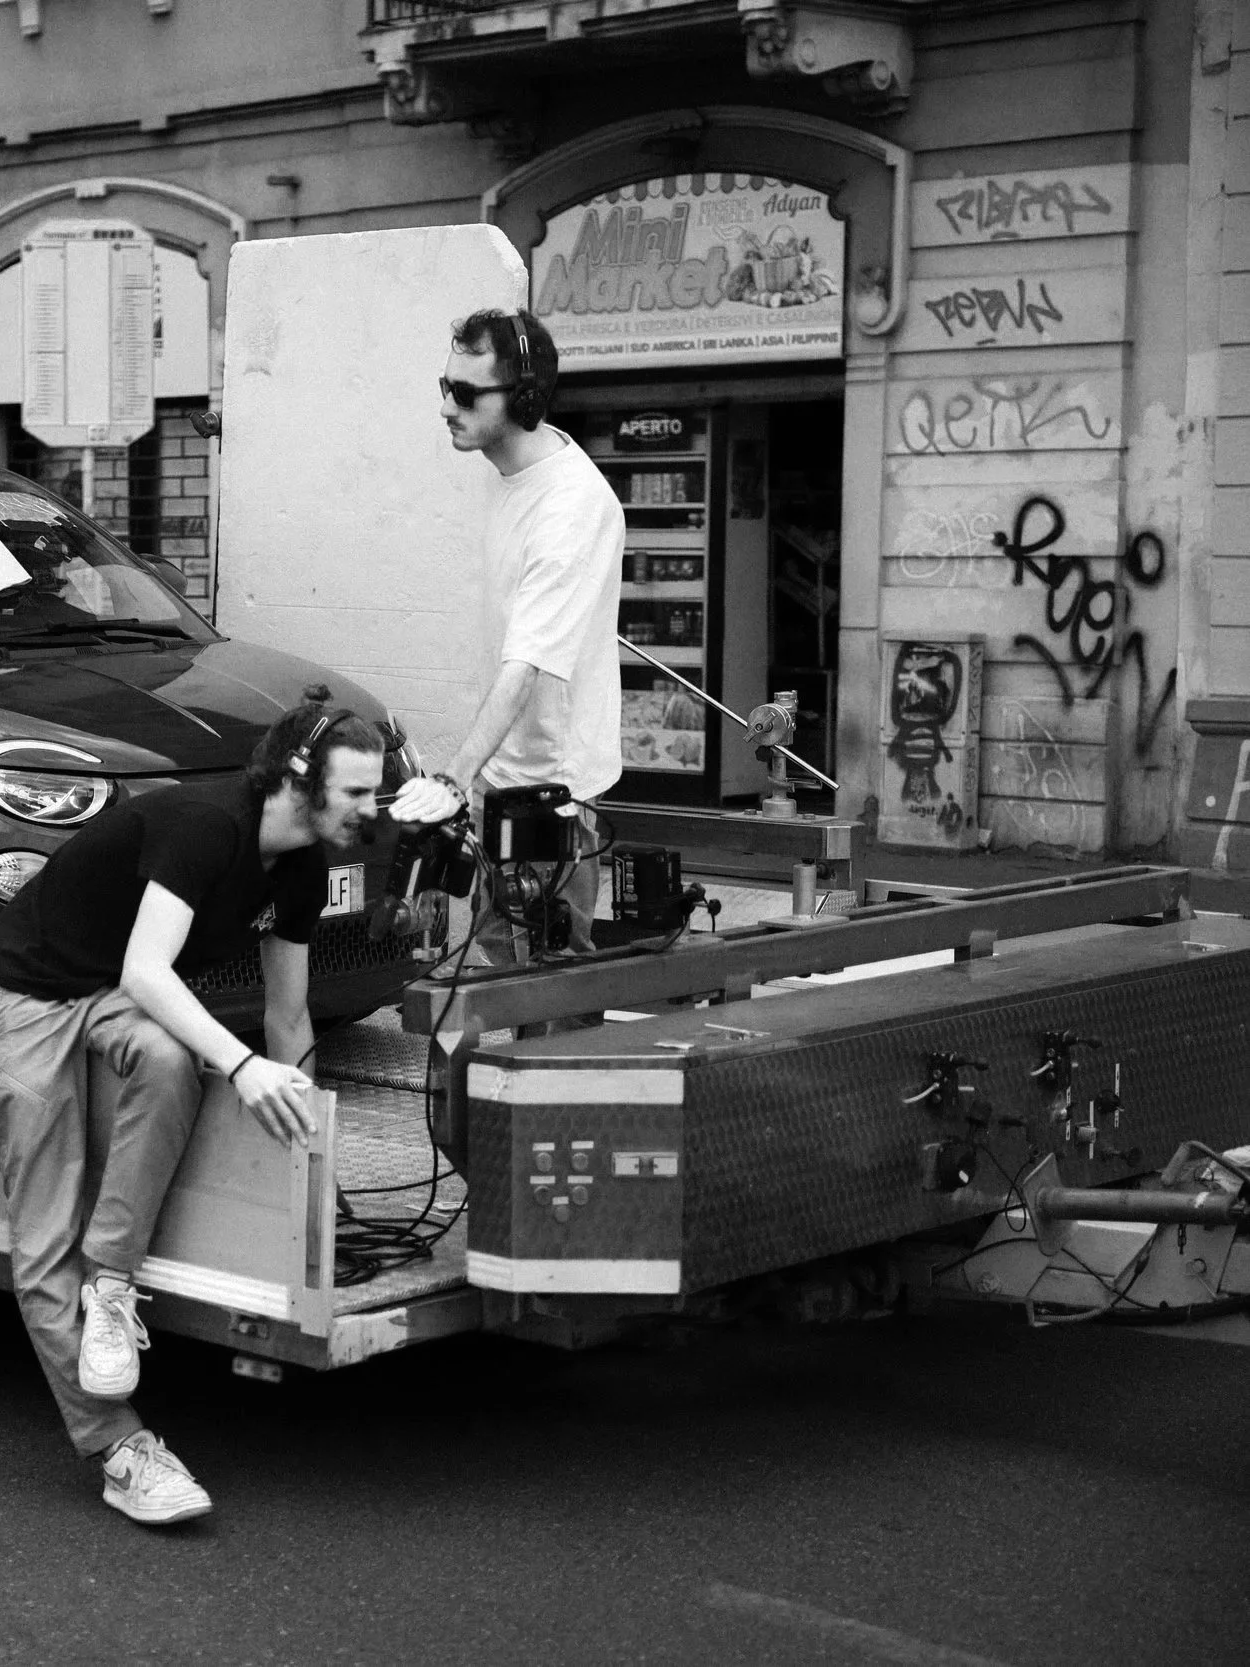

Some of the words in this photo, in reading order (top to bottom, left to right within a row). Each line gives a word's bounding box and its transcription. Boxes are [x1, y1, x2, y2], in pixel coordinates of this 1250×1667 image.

[763, 193, 821, 218] Adyan
[572, 202, 690, 266] Mini
[536, 246, 729, 317] Market
[630, 342, 650, 353] SUD
[652, 340, 695, 352] AMERICA
[702, 338, 716, 350] SRI
[718, 336, 754, 349] LANKA
[761, 335, 784, 347] ASIA
[791, 331, 839, 345] FILIPPINE
[619, 419, 682, 435] APERTO
[330, 876, 349, 907] LF
